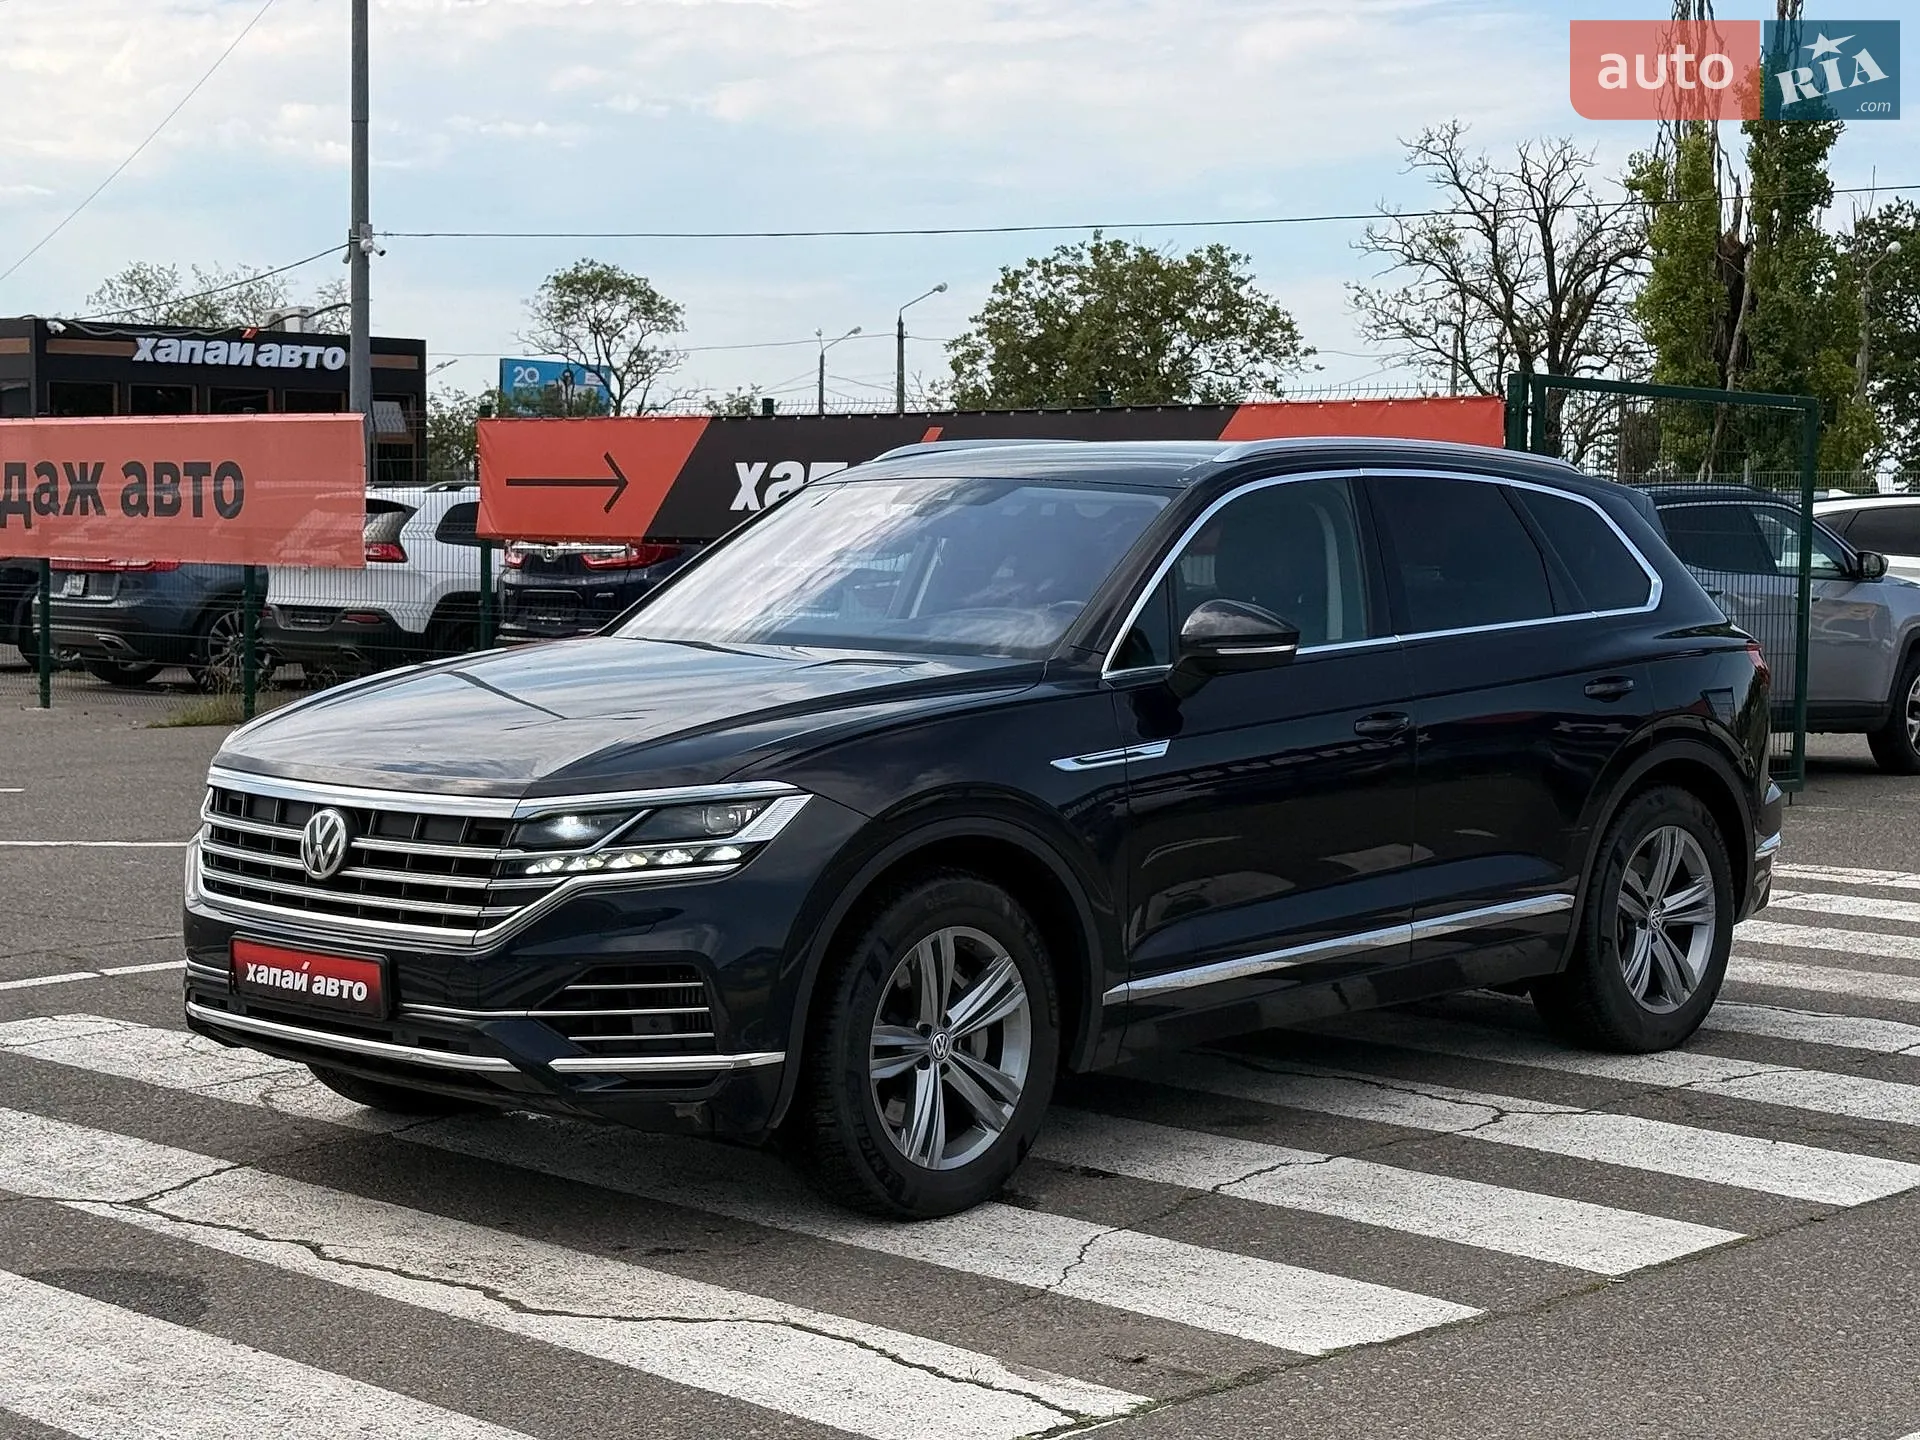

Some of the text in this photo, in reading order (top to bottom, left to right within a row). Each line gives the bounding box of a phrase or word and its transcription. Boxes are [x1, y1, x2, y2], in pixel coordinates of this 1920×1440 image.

[256, 342, 346, 371] авто
[121, 460, 245, 519] авто
[311, 975, 368, 1002] авто
